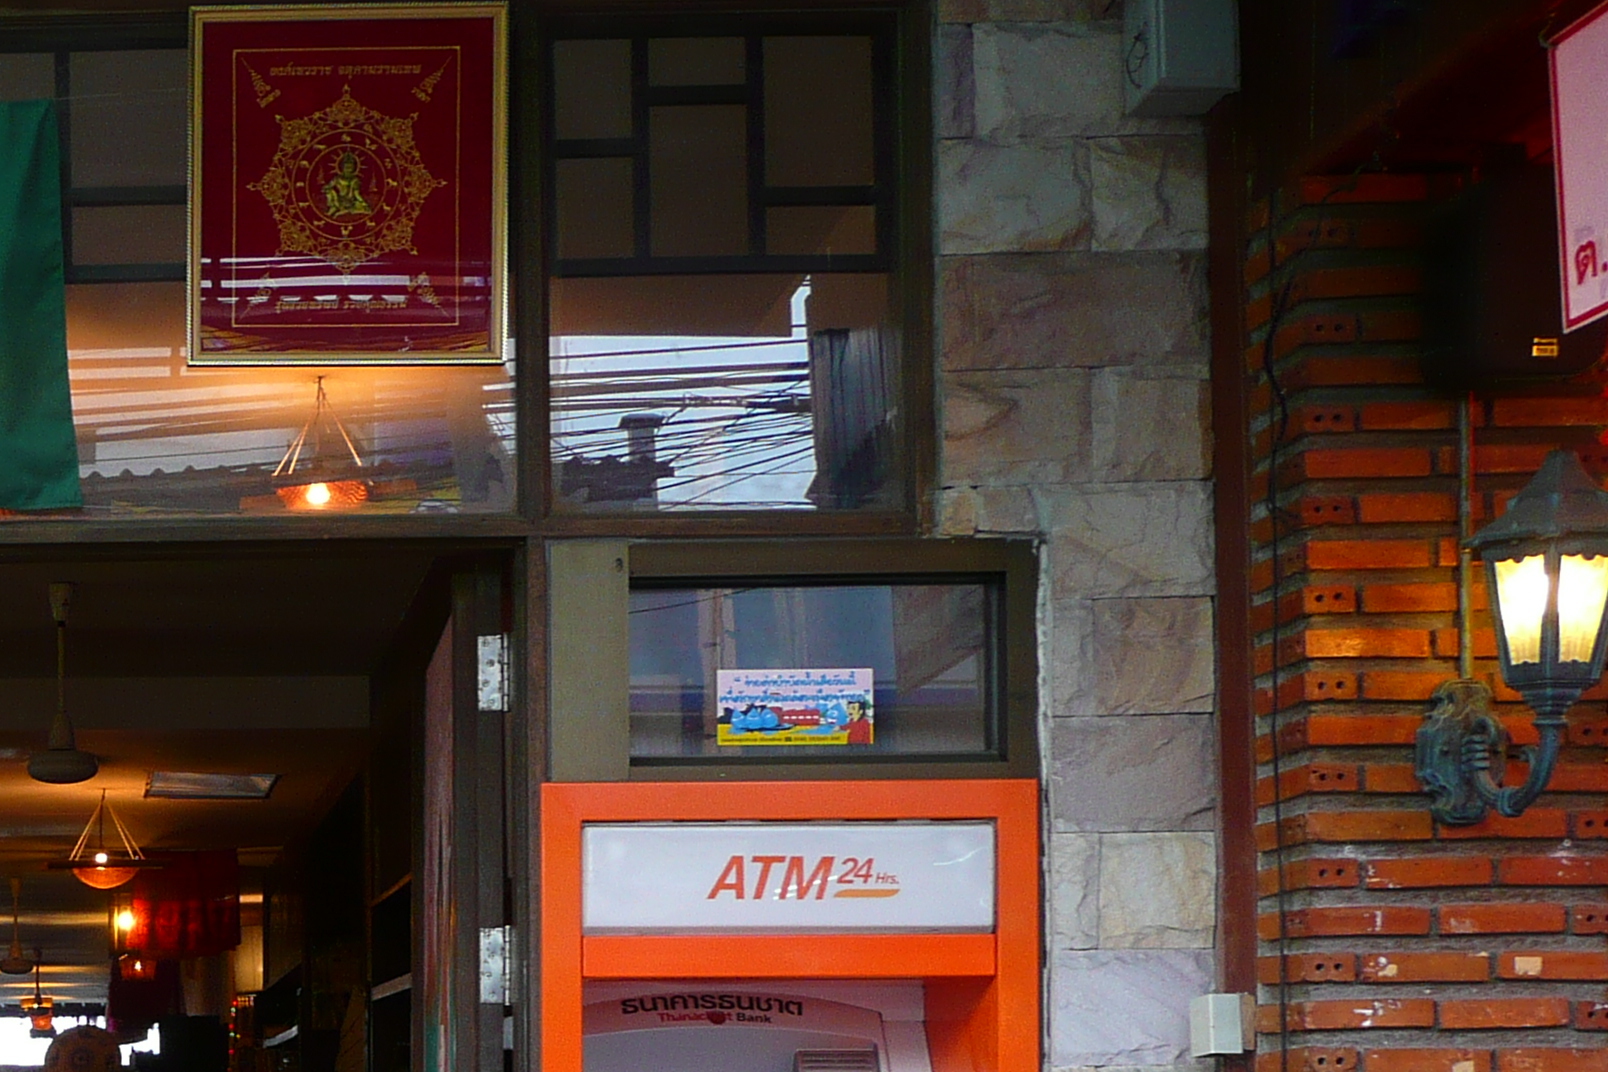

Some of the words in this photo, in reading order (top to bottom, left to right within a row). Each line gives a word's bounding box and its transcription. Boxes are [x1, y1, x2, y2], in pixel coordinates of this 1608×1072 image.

[707, 855, 836, 901] ATM
[836, 857, 874, 885] 24
[620, 993, 804, 1017] ธนาคารธนชาต
[735, 1011, 773, 1024] Bank
